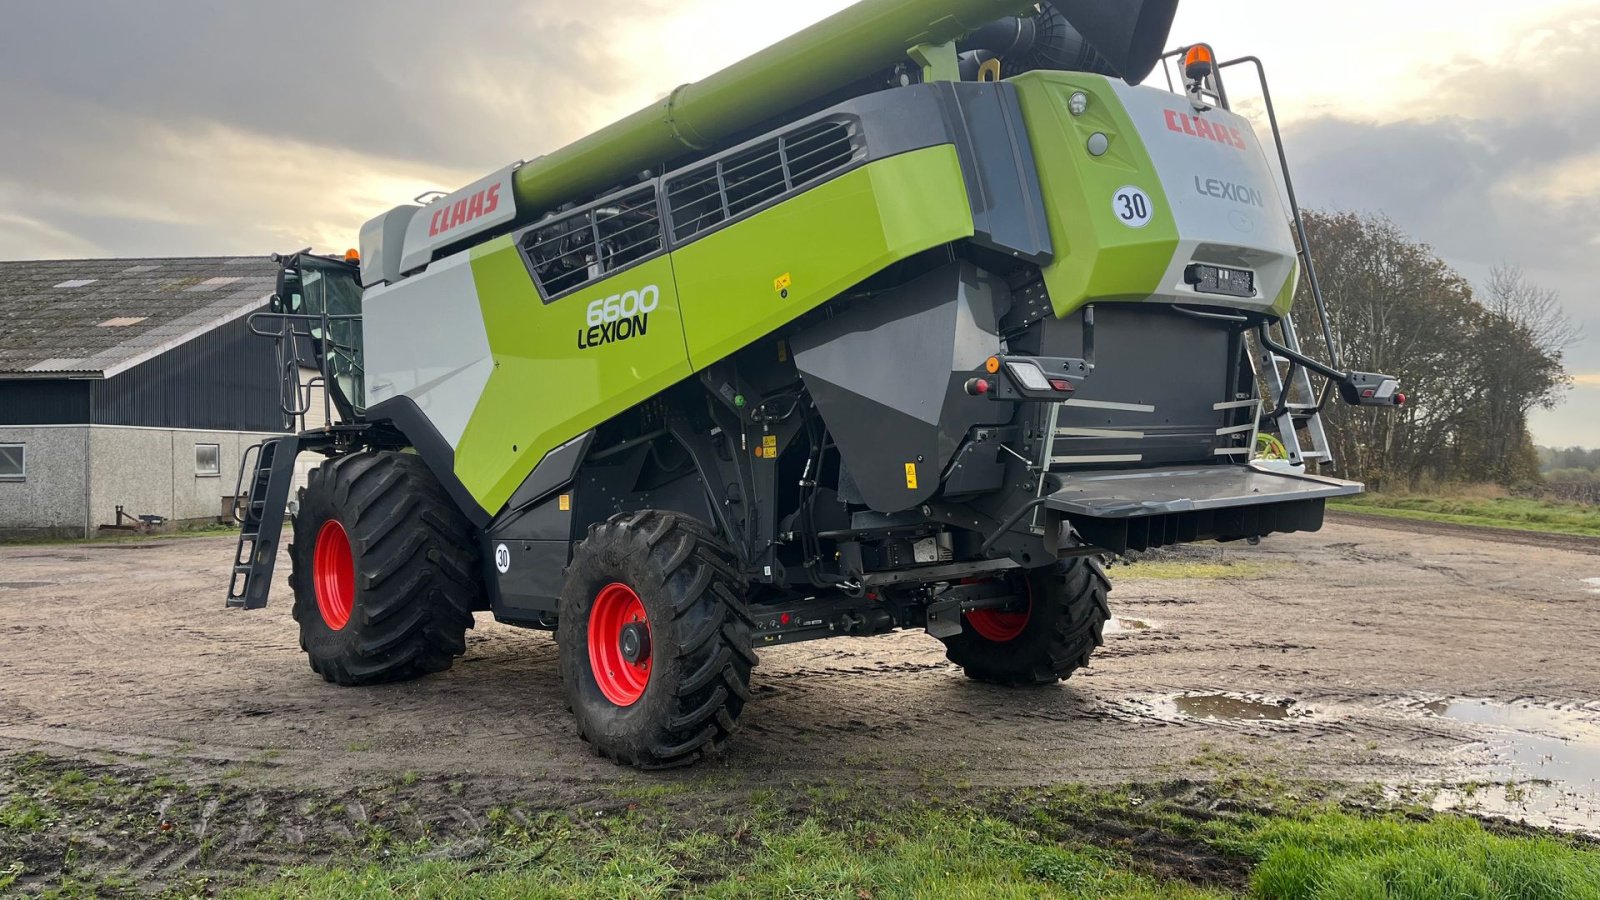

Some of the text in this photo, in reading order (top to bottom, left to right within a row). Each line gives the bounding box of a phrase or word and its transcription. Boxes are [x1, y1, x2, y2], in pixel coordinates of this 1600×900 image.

[1163, 109, 1246, 150] CLAAS
[428, 182, 501, 238] CLAAS
[1117, 193, 1147, 220] 30
[1194, 175, 1264, 208] LEXION
[586, 284, 659, 328] 6600
[577, 312, 648, 350] LEXION
[497, 549, 508, 568] 30
